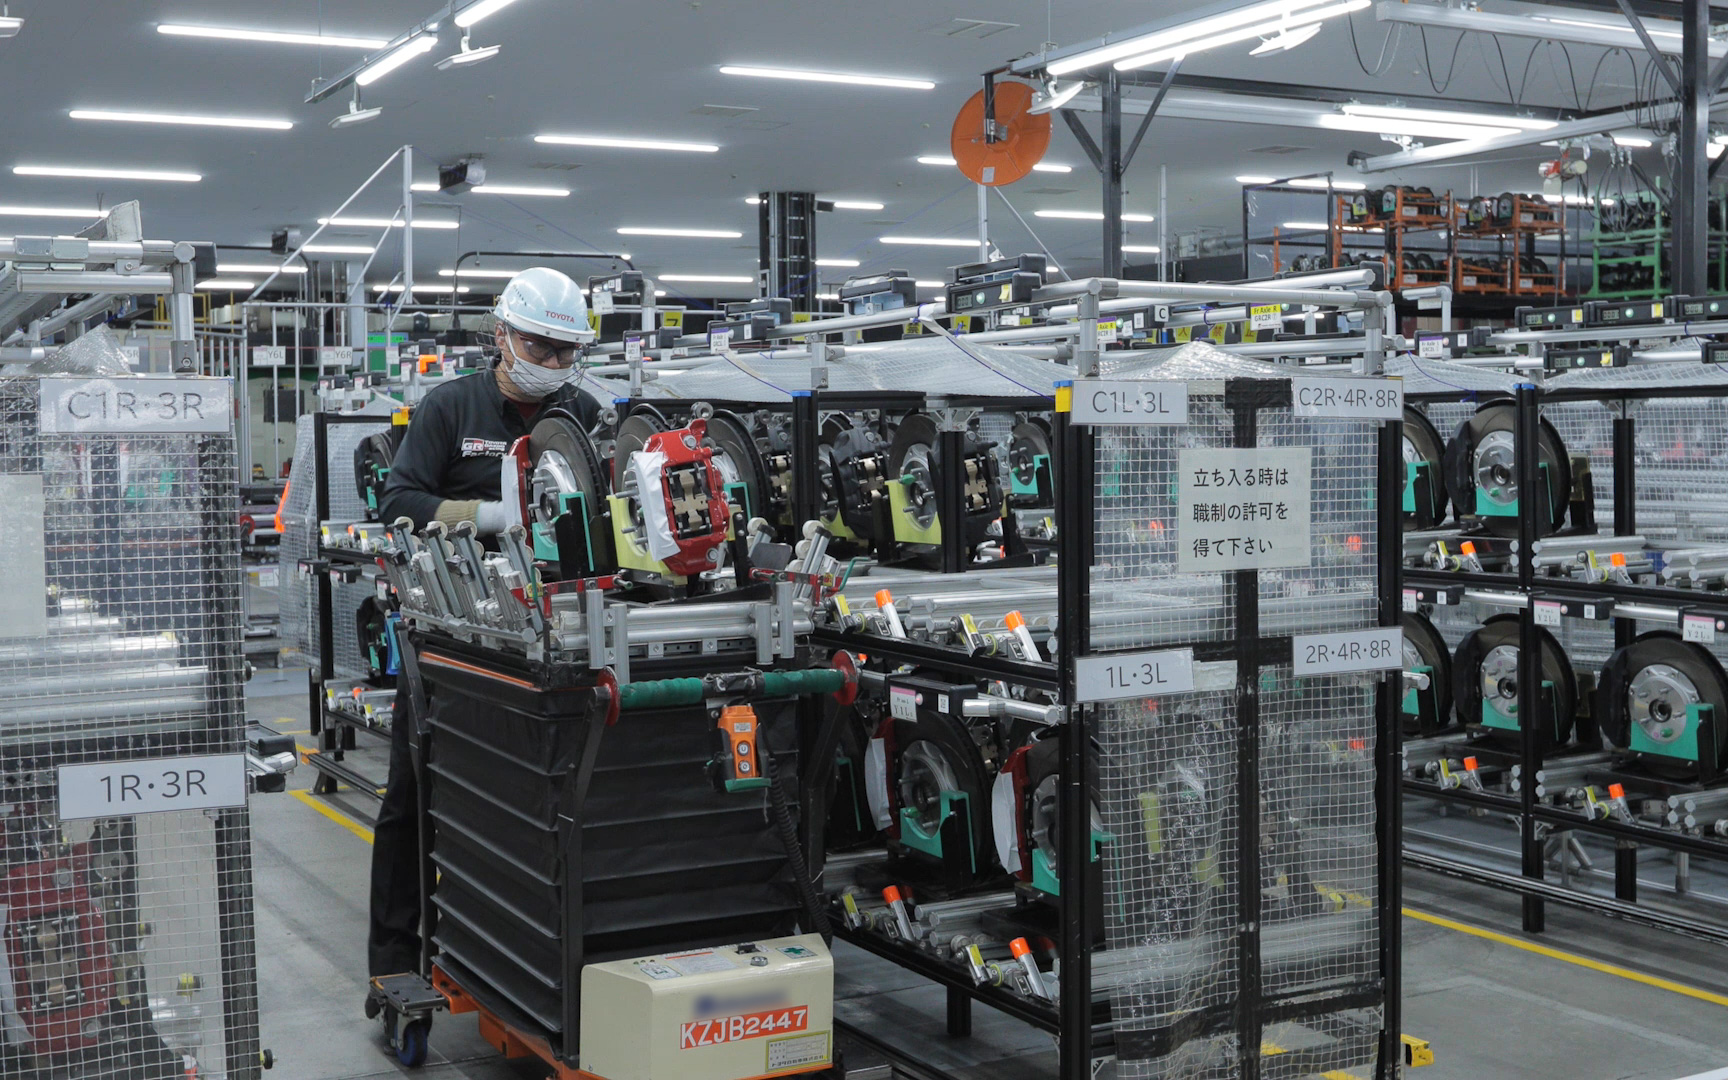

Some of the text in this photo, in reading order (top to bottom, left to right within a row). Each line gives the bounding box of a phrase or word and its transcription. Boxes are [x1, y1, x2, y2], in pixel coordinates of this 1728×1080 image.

[545, 310, 575, 323] TOYOTA
[1158, 307, 1166, 319] C
[267, 351, 284, 360] Y6L
[335, 351, 353, 360] Y6R
[462, 443, 484, 451] GR
[1193, 467, 1289, 487] 立ち入る時は
[1192, 501, 1289, 523] 職制の許可を
[1192, 536, 1273, 558] 得て下さい
[1305, 639, 1392, 665] 2R·4R·8R
[1105, 662, 1168, 689] 1L·3L
[99, 769, 208, 803] 1R·3R
[680, 1008, 807, 1049] KZJB2447
